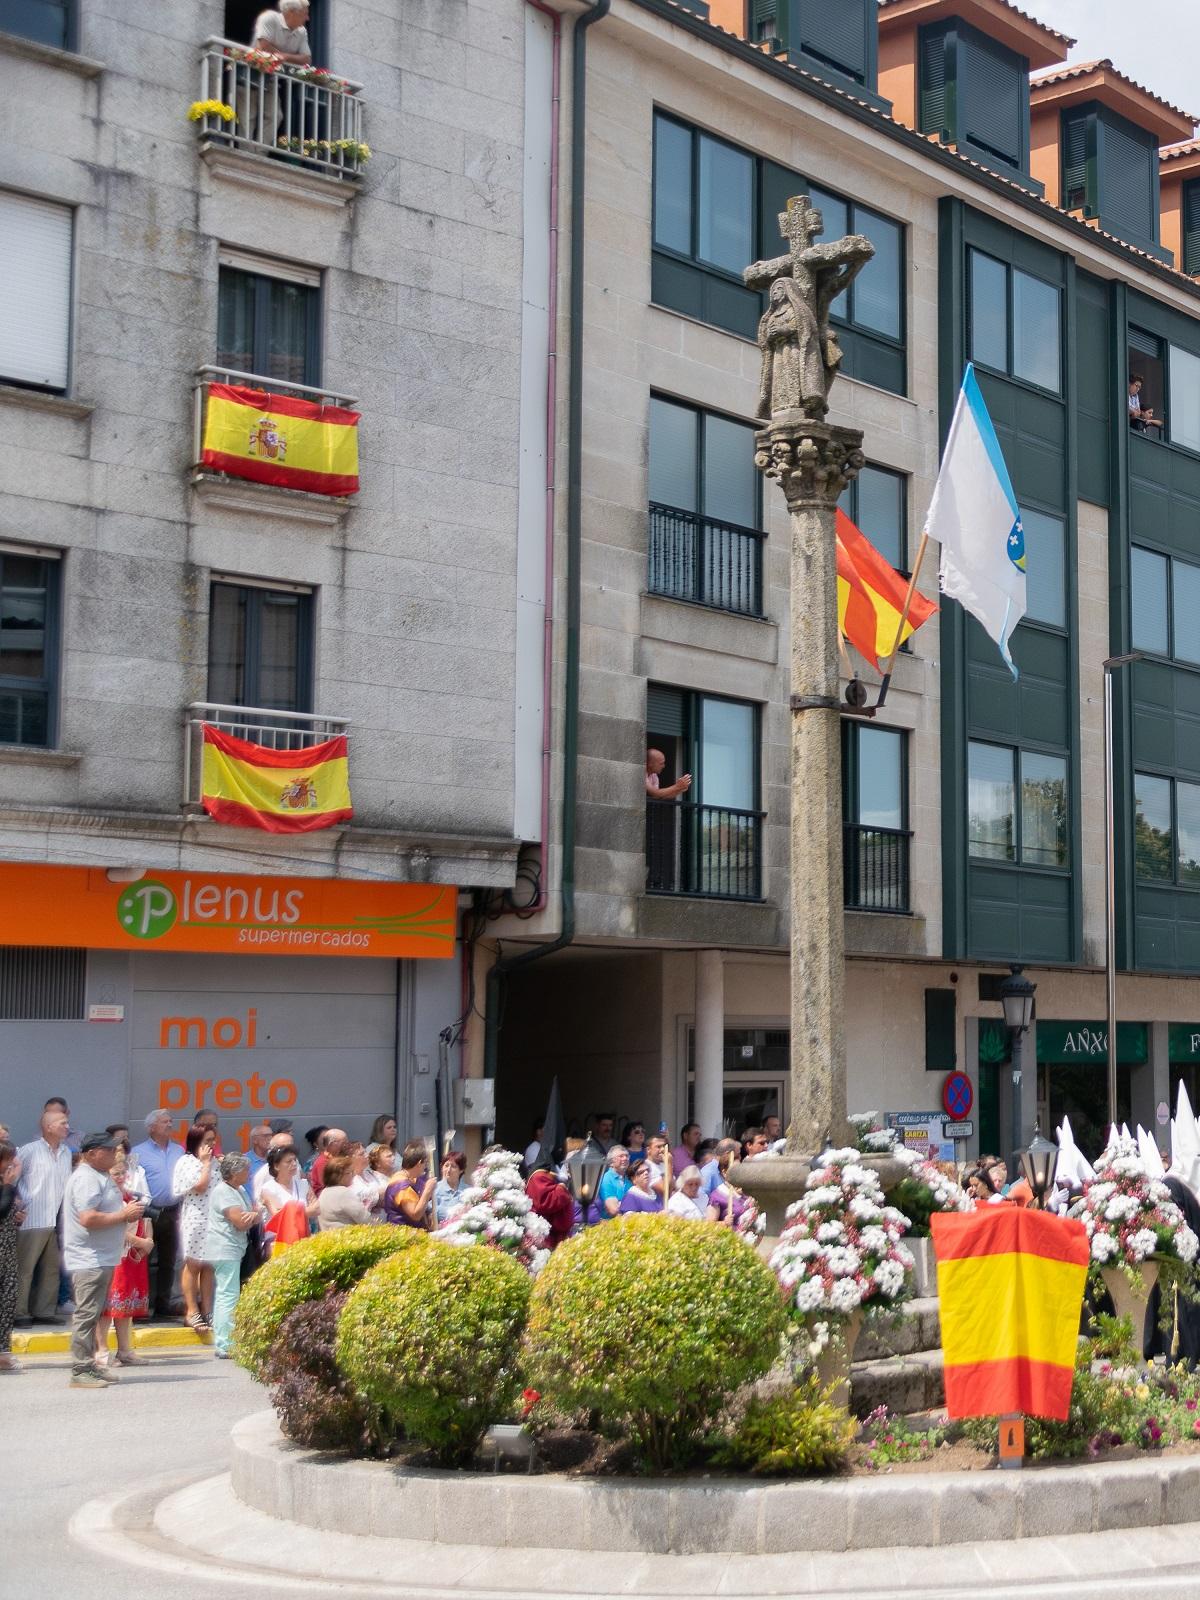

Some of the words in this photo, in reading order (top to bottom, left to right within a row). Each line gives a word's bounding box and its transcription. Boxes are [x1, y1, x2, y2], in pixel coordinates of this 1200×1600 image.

[238, 928, 371, 947] supermercados
[160, 1008, 257, 1049] moi
[159, 1072, 298, 1111] preto
